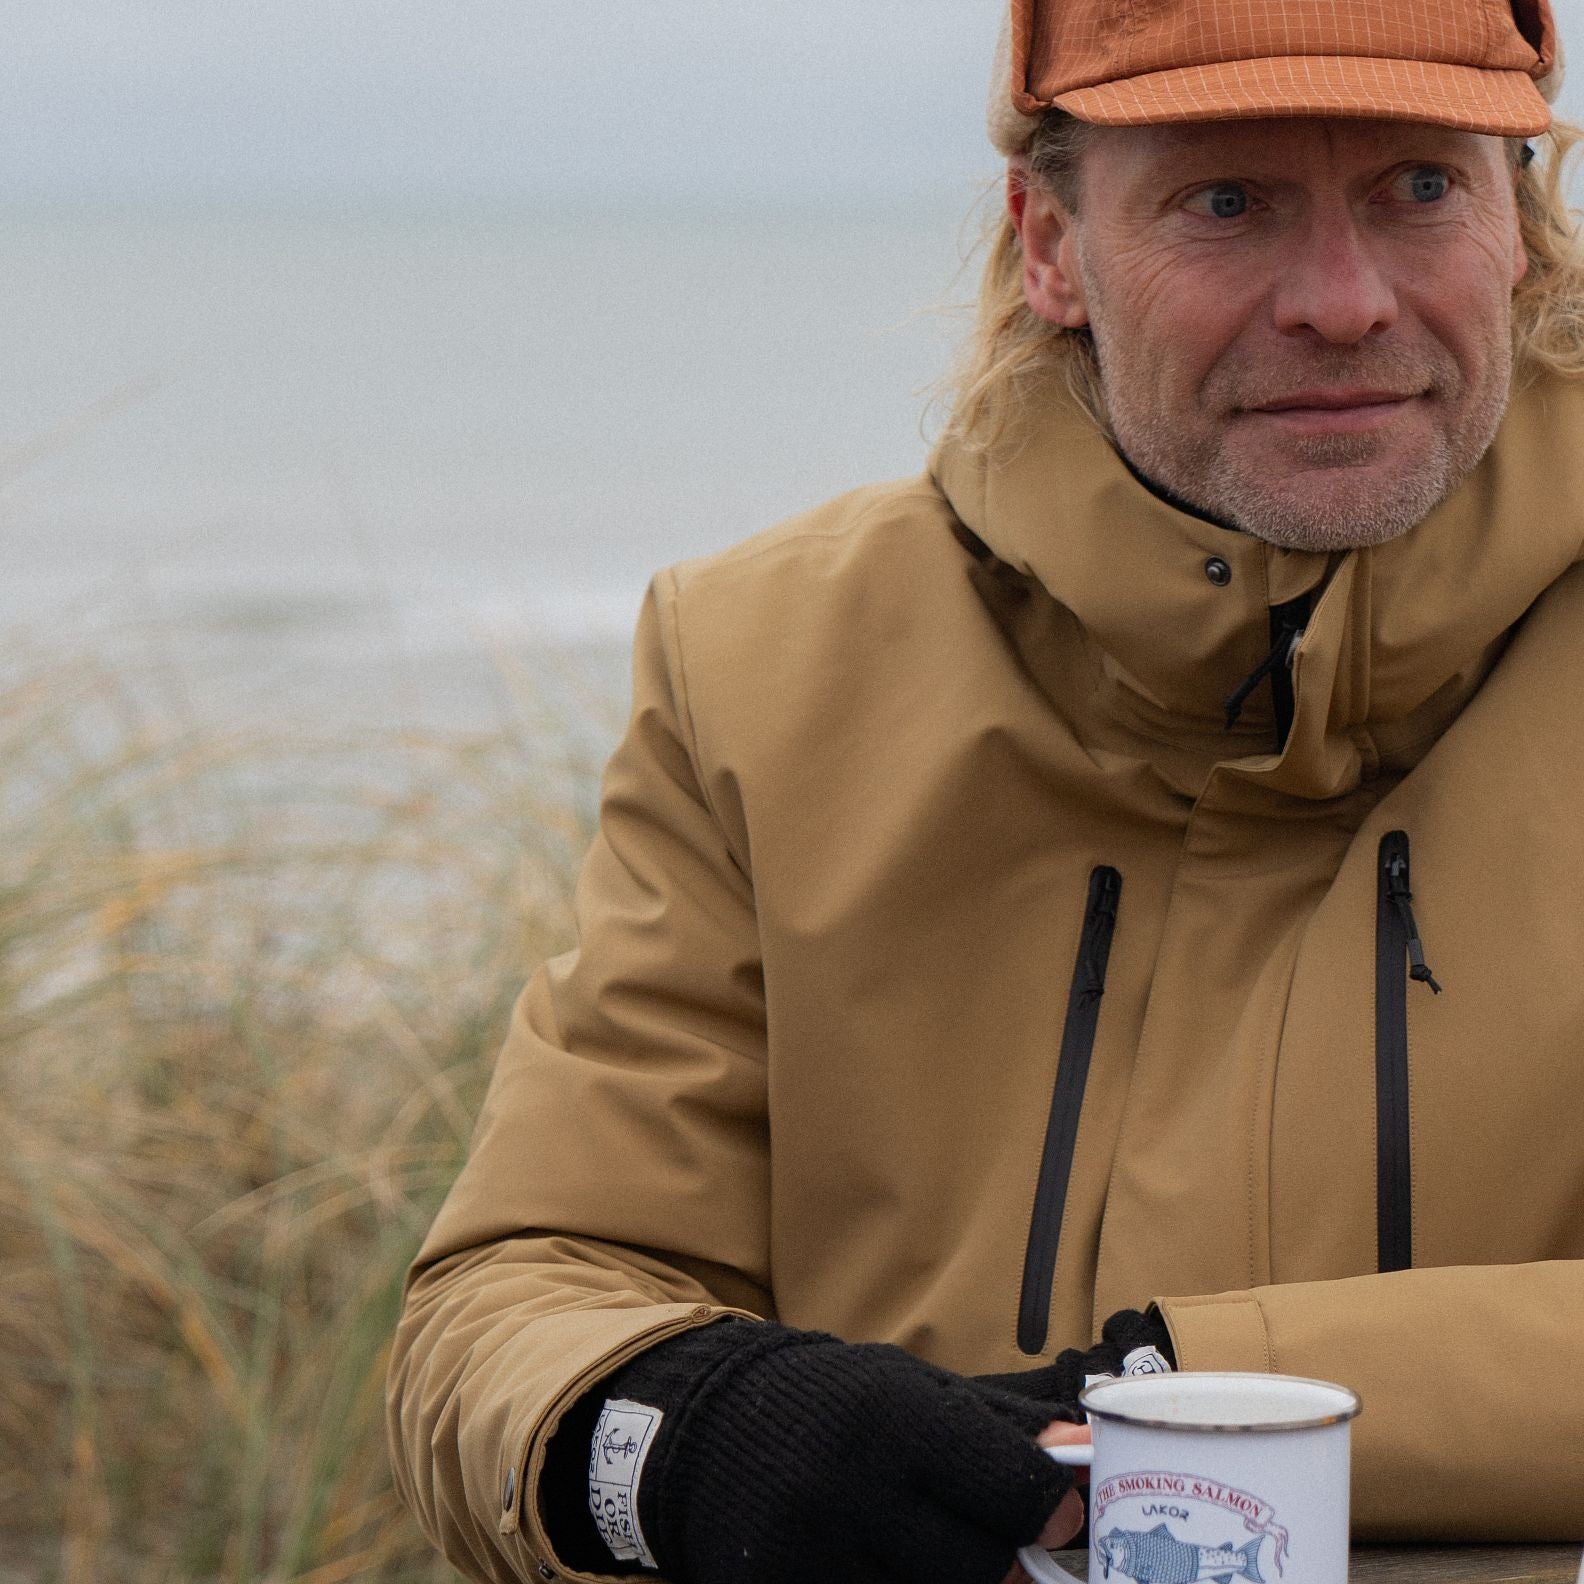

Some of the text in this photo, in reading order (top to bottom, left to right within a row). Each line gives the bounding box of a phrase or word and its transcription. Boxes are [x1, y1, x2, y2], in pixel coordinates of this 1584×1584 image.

[591, 1487, 613, 1544] DIE
[1097, 1477, 1263, 1517] THE SMOKING SALMON
[1141, 1504, 1190, 1521] LAKOR
[604, 1498, 621, 1537] OR
[617, 1491, 638, 1549] FISH
